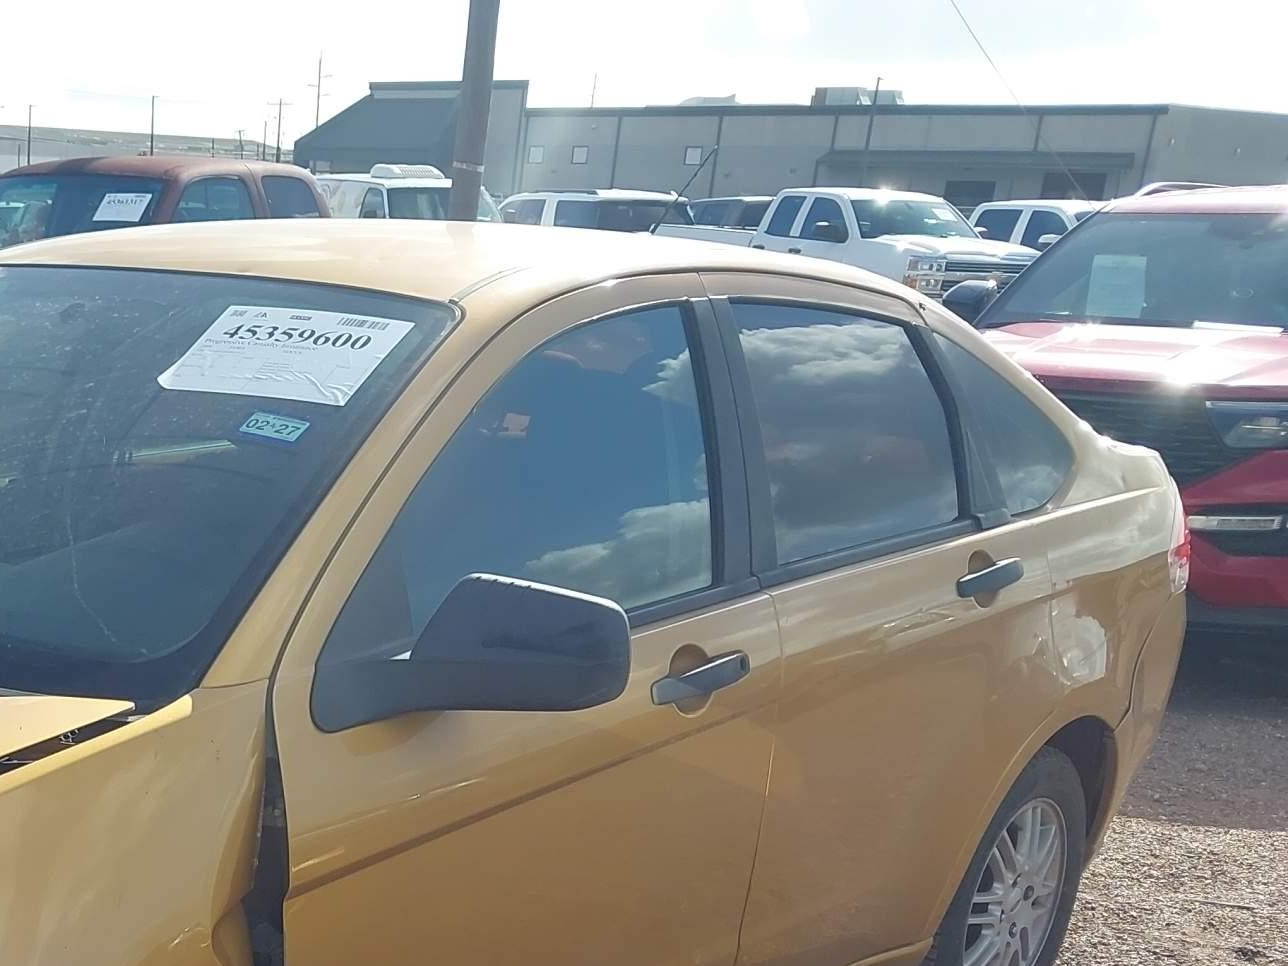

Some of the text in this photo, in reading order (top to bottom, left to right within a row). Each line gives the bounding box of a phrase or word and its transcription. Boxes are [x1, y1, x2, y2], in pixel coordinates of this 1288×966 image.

[223, 323, 373, 351] 45359600
[245, 418, 270, 431] 02
[274, 423, 301, 436] 27
